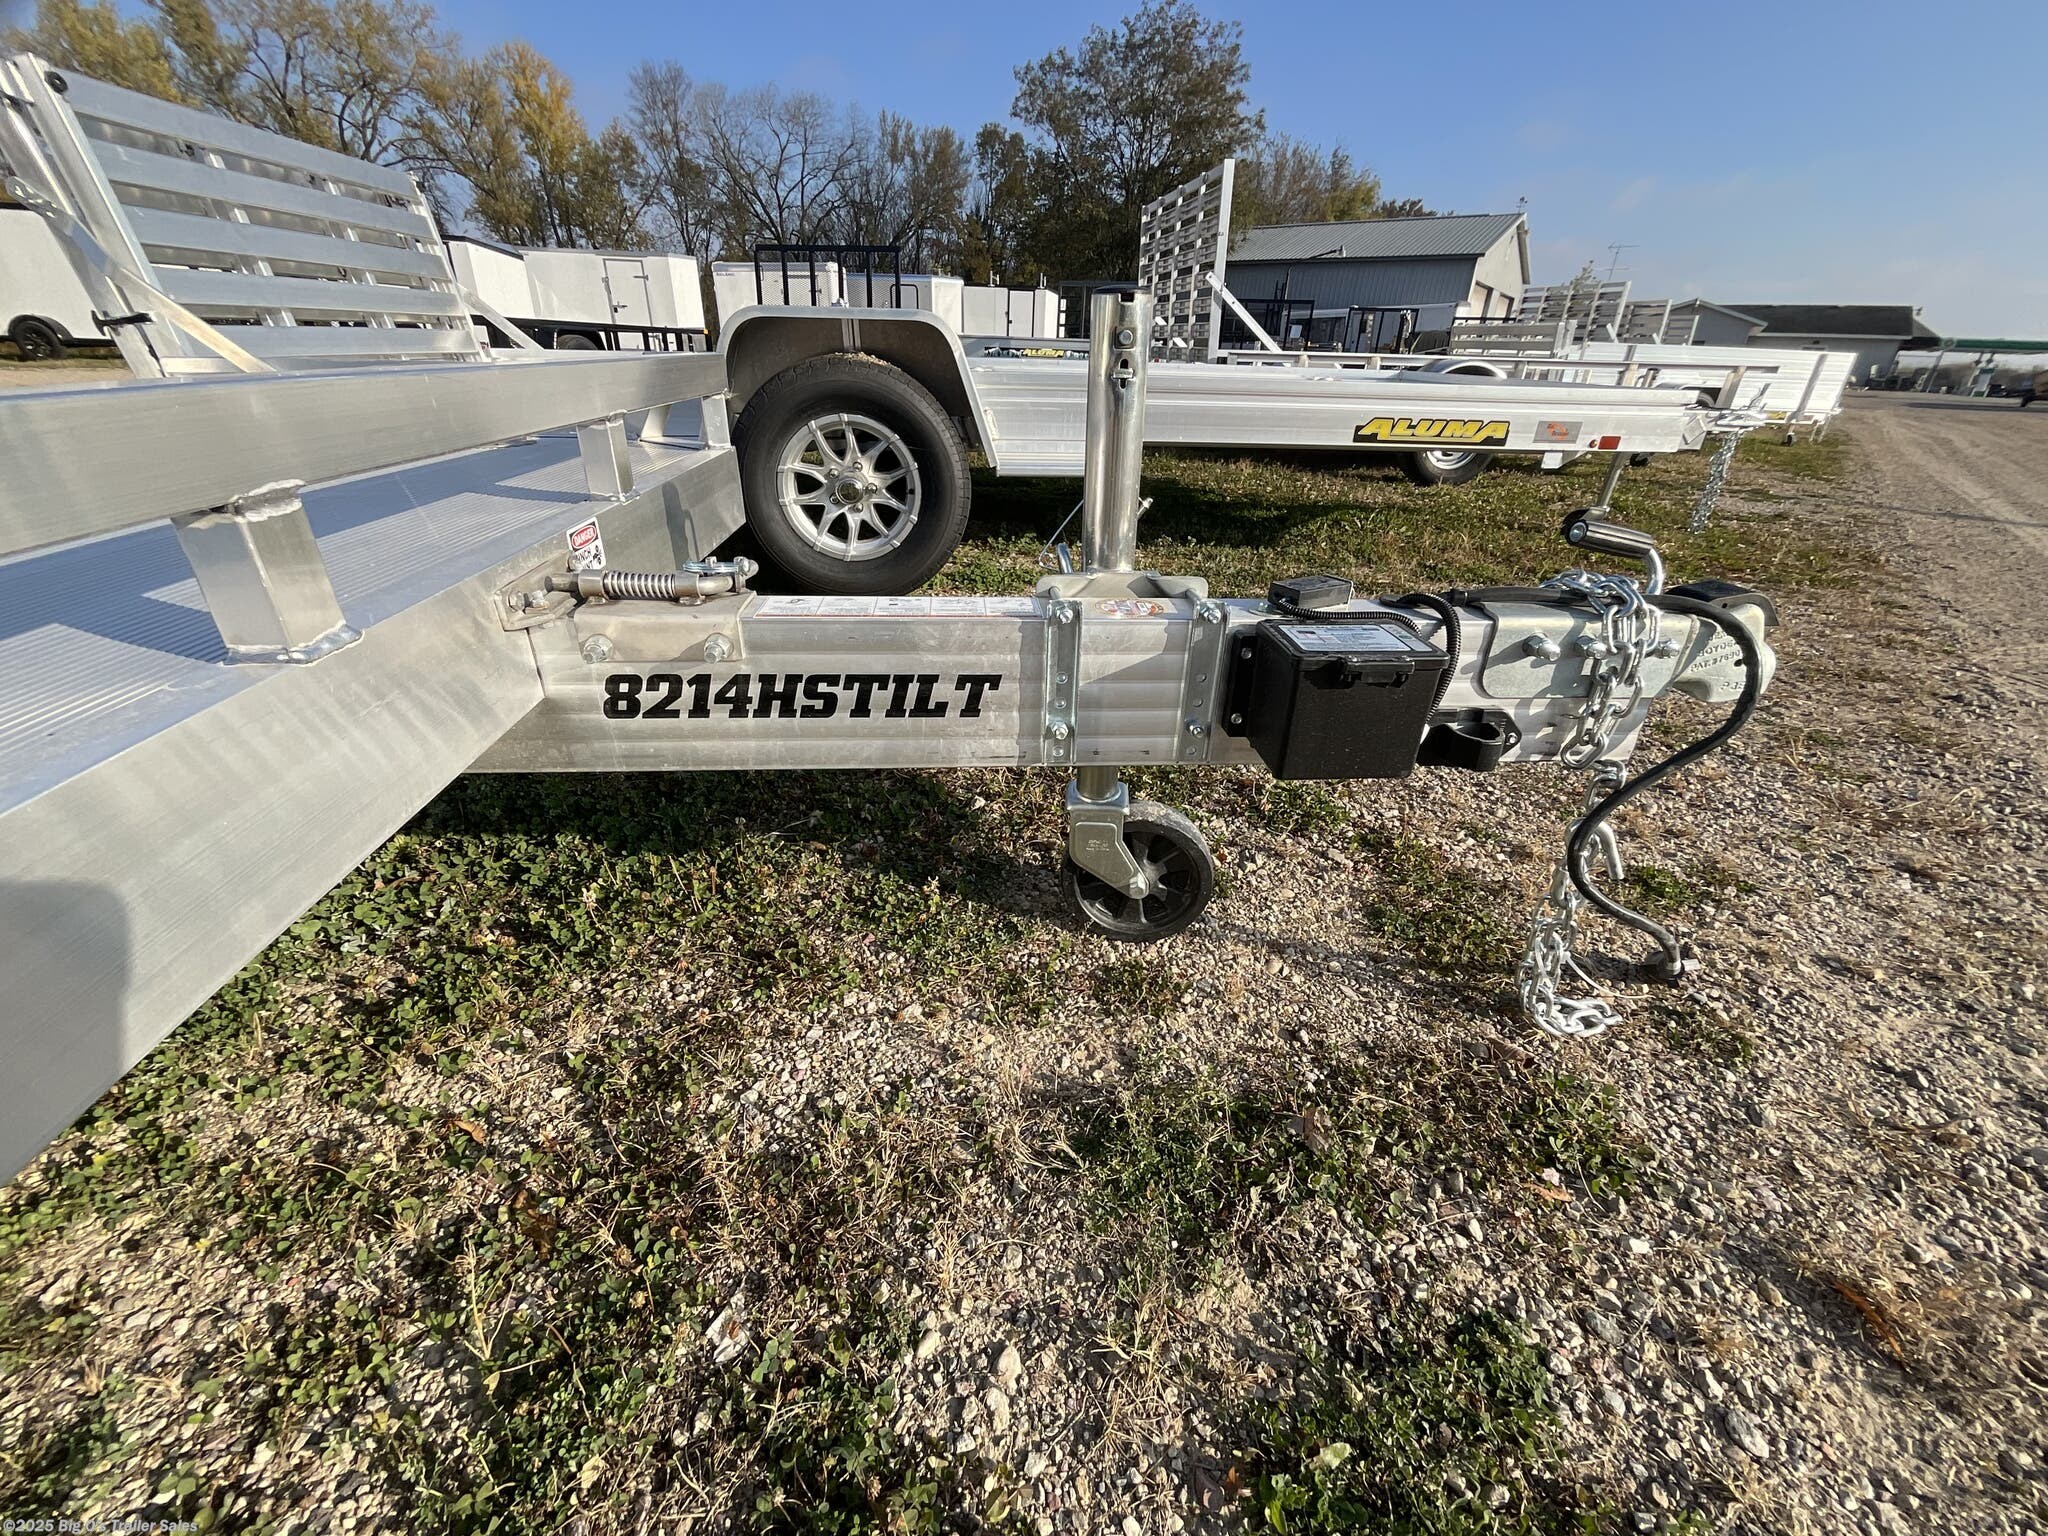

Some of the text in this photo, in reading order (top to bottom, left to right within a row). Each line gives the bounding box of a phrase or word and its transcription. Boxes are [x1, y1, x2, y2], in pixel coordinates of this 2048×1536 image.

[1357, 417, 1510, 443] ALUMA
[573, 528, 596, 547] DANGER
[603, 674, 1001, 719] 8214HSTILT
